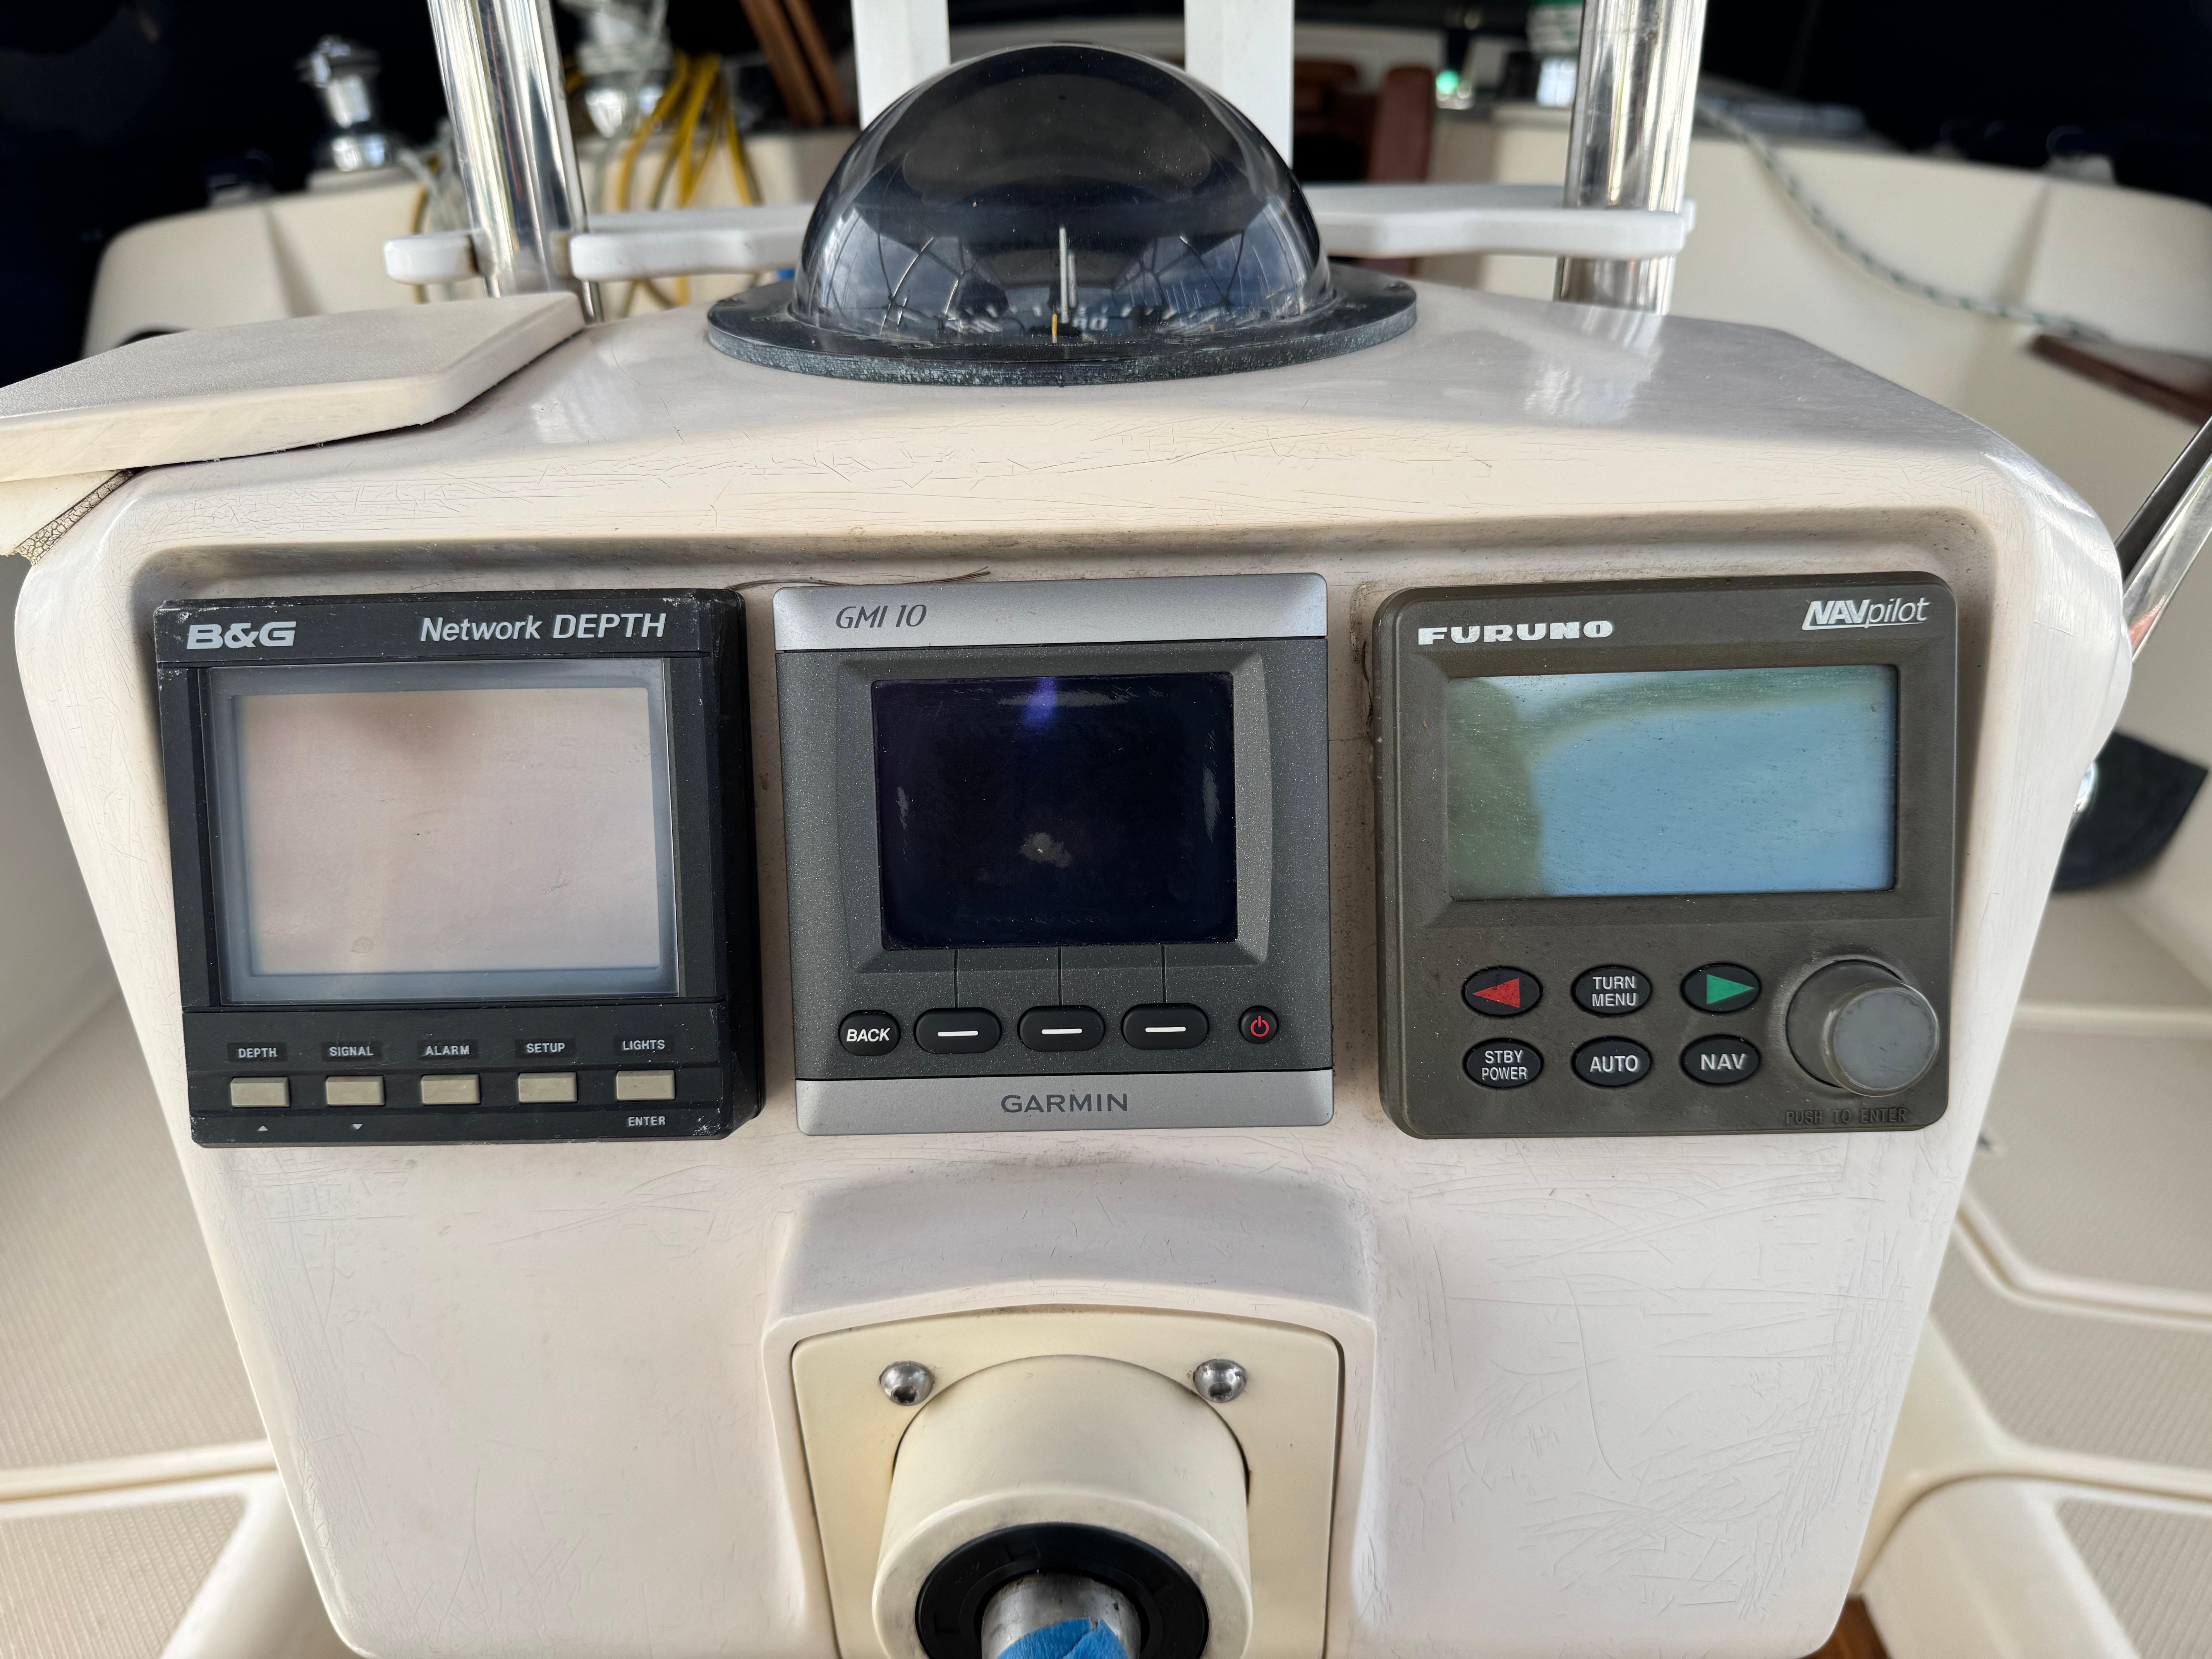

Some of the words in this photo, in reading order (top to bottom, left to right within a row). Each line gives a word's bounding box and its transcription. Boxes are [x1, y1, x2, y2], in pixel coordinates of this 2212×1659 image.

[836, 605, 888, 629] GMI
[895, 604, 927, 627] 10
[420, 615, 543, 642] Network
[552, 613, 666, 639] DEPTH
[1418, 620, 1613, 645] FURUNO
[186, 621, 297, 650] B&G
[1592, 975, 1635, 989] TURN
[1592, 992, 1636, 1006] MENU
[846, 1027, 890, 1042] BACK
[238, 1047, 278, 1058] DEPTH
[329, 1046, 374, 1057] SIGNAL
[424, 1045, 470, 1056] ALARM
[526, 1042, 565, 1053] SETUP
[622, 1039, 666, 1051] LIGHTS
[1484, 1049, 1523, 1064] STBY
[1590, 1054, 1639, 1073] AUTO
[1701, 1053, 1746, 1070] NAV
[1482, 1066, 1527, 1080] POWER
[1001, 1093, 1127, 1113] GARMIN
[628, 1116, 666, 1127] ENTER
[1786, 1110, 1822, 1124] PUSH
[1832, 1109, 1851, 1123] TO
[1860, 1107, 1907, 1123] ENTER
